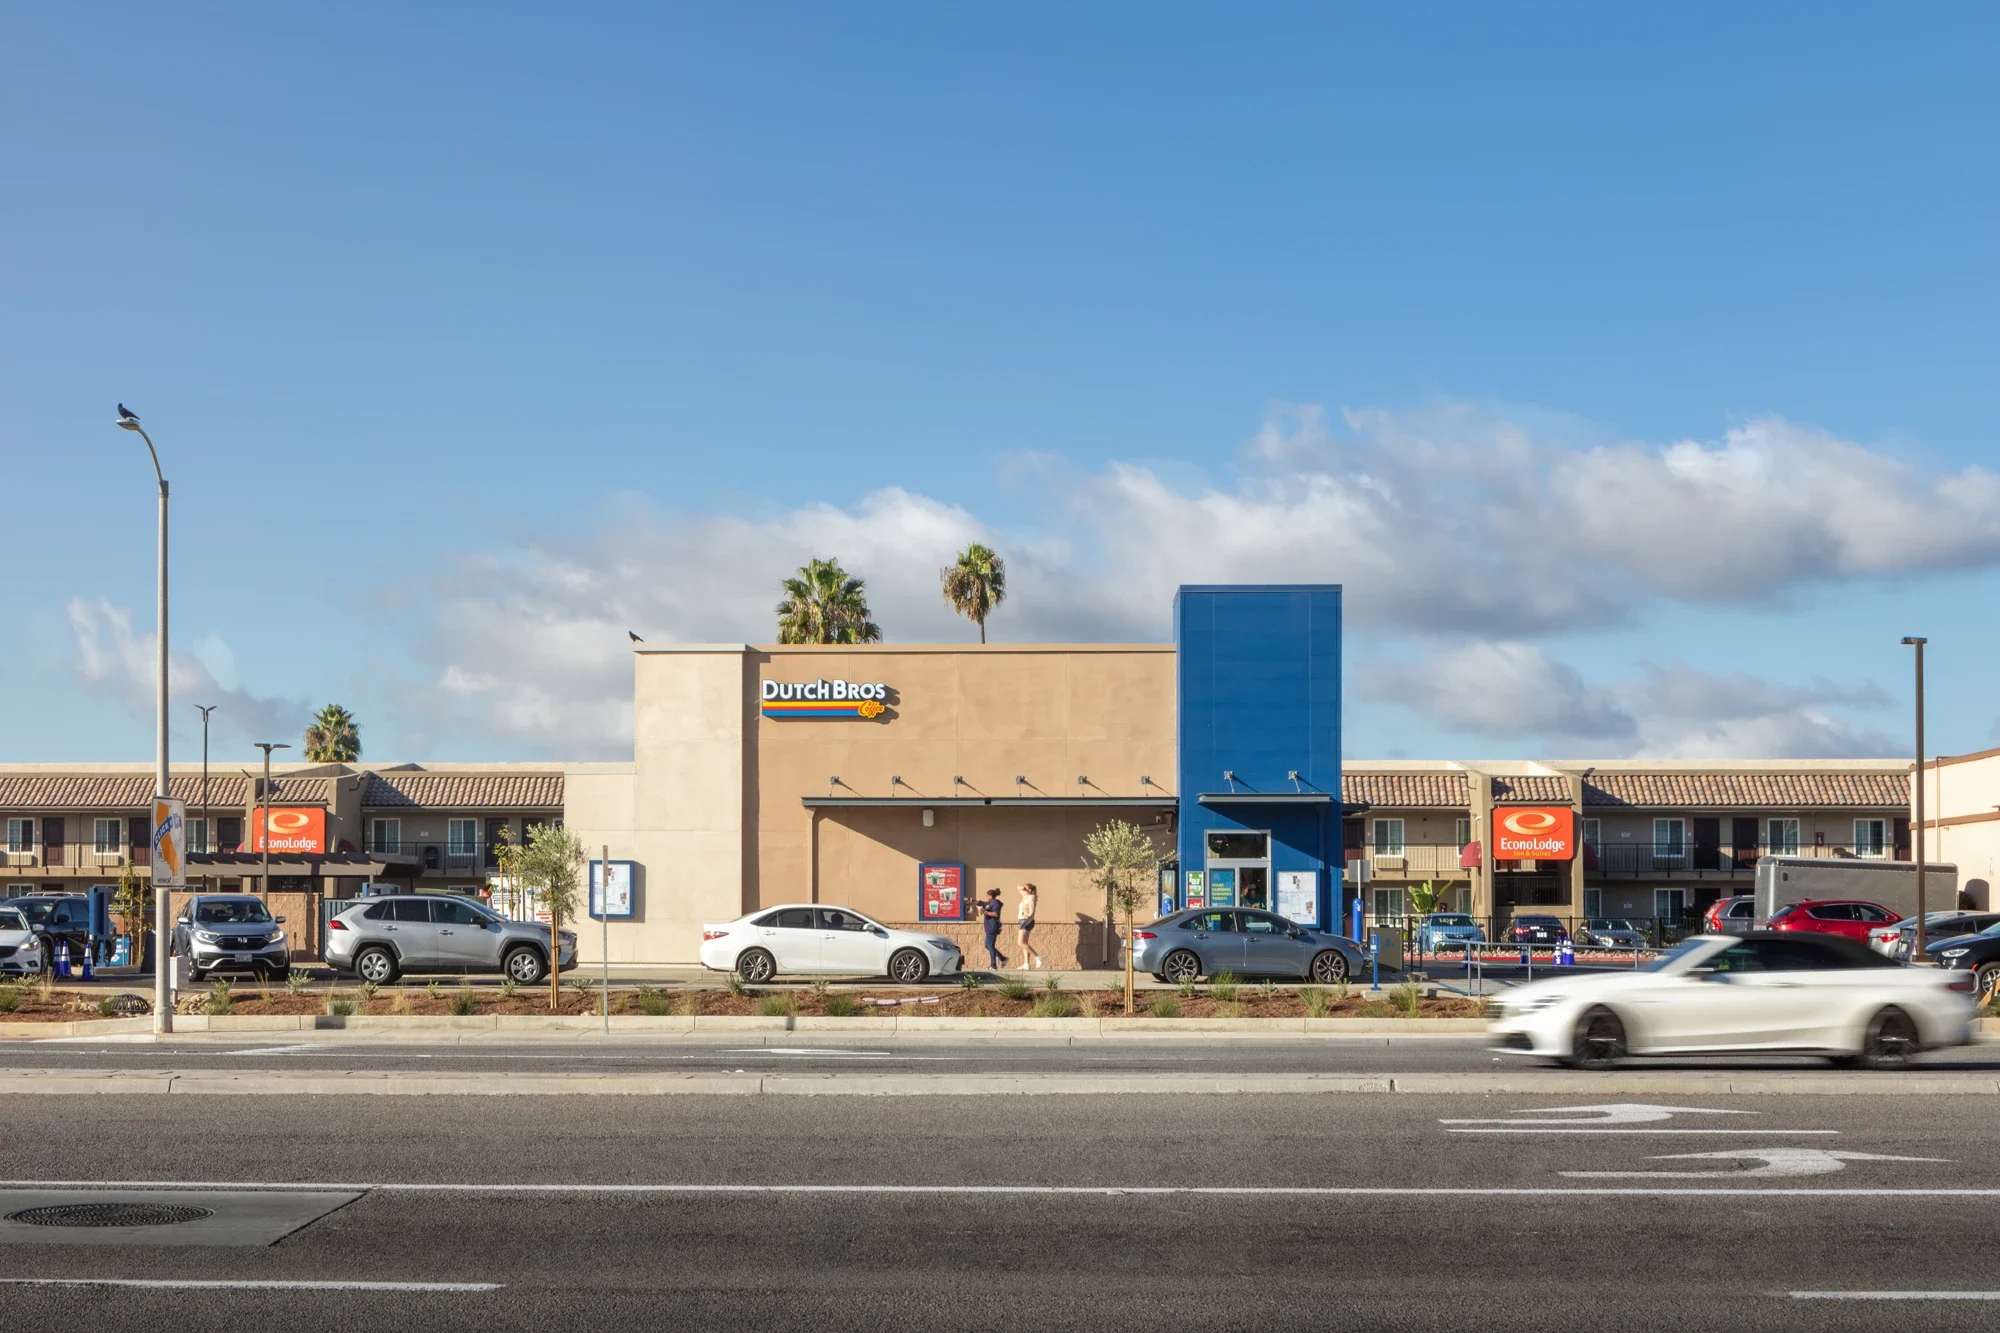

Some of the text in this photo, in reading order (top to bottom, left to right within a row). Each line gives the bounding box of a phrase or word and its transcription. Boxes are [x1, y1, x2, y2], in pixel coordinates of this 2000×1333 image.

[832, 679, 886, 700] BROS
[858, 700, 885, 718] Coffee
[1500, 838, 1565, 852] EconoLodge
